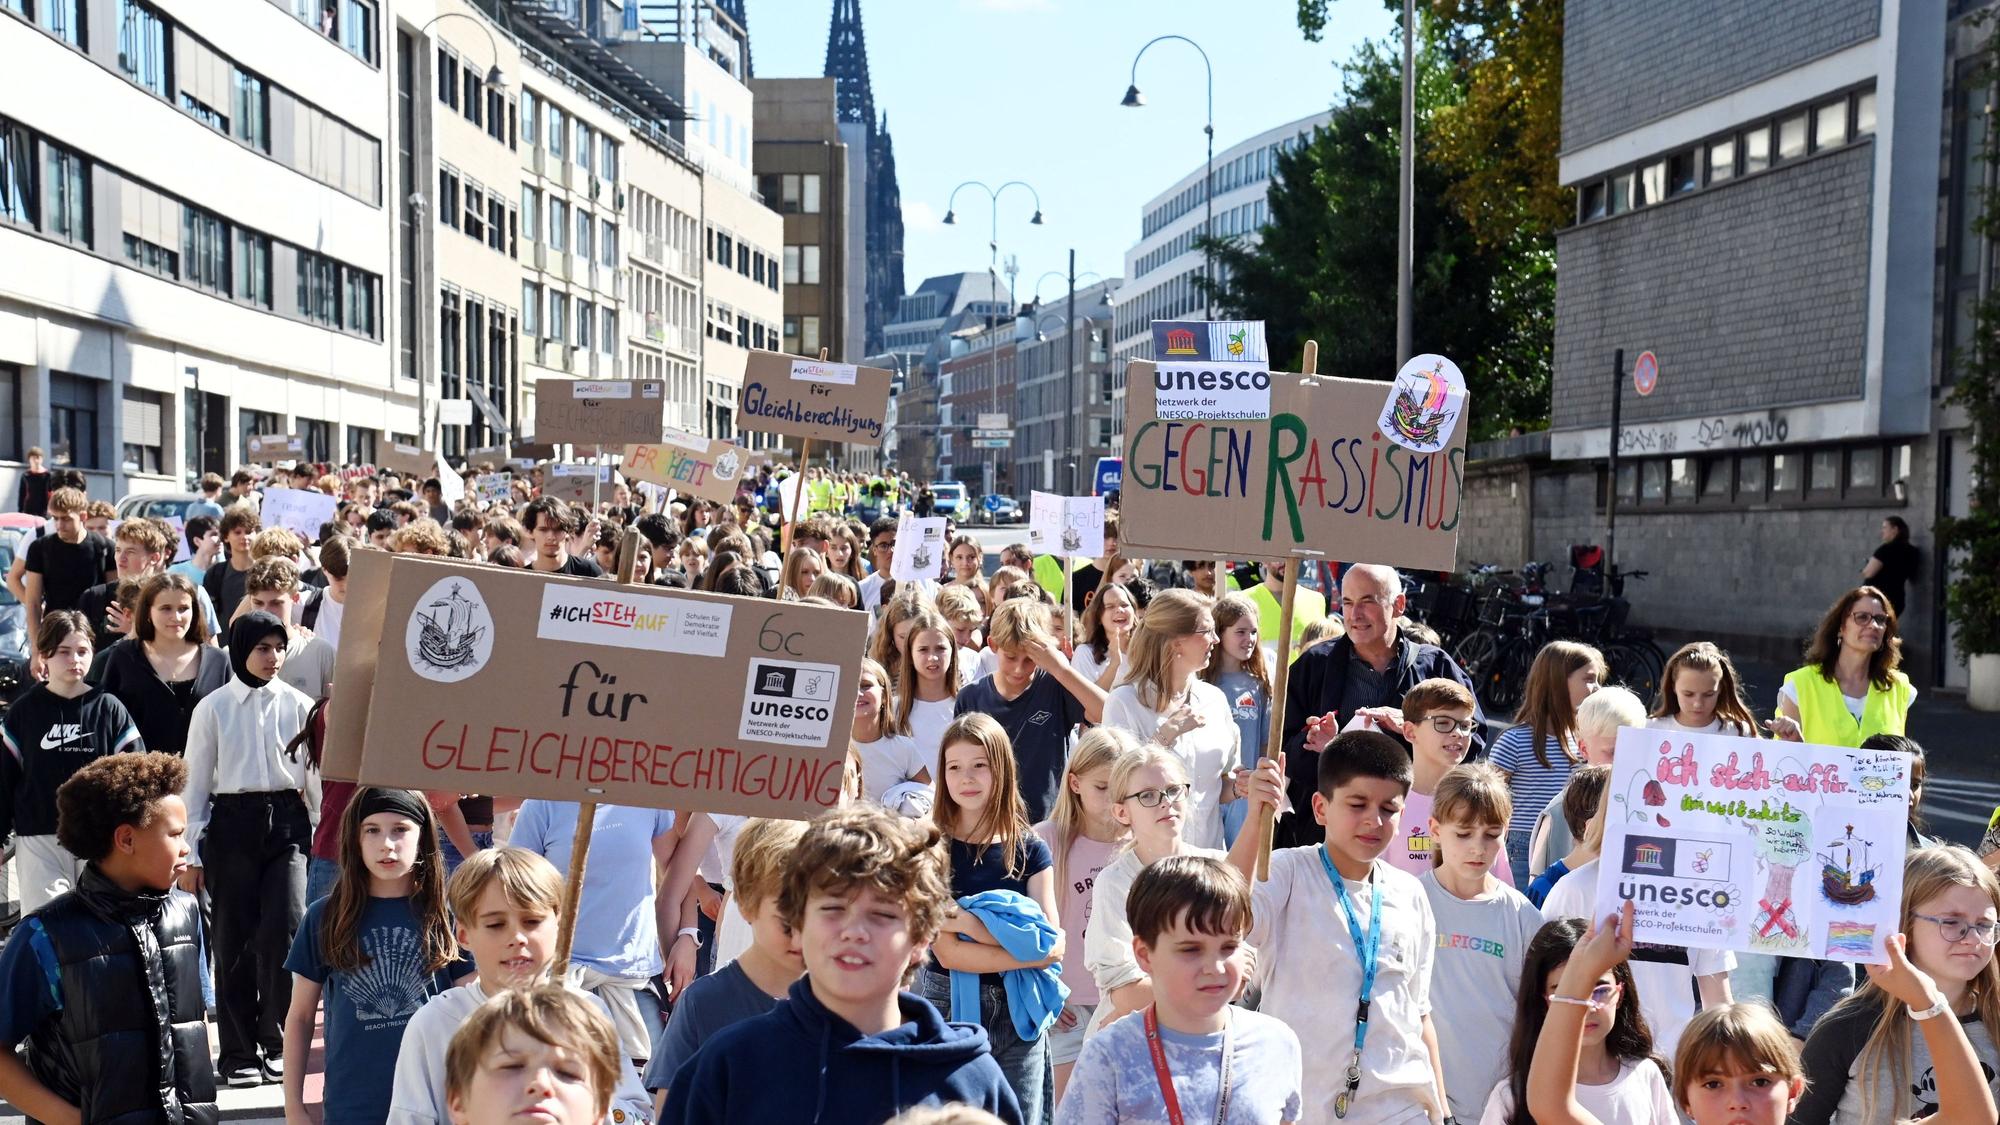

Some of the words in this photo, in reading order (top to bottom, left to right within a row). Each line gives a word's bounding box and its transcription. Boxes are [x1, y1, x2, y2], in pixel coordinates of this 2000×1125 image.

[1154, 371, 1270, 390] unesco
[810, 384, 833, 396] für
[1155, 397, 1199, 406] Netzwerk
[1201, 397, 1217, 406] der
[743, 382, 882, 438] Gleichberechtigung
[1155, 410, 1266, 420] UNESCO-Projektschulen
[1129, 421, 1251, 498] GEGEN
[686, 612, 711, 621] Schulen
[559, 660, 649, 723] für
[750, 701, 829, 721] unesco
[48, 723, 81, 738] NIKE
[748, 720, 778, 729] Netzwerk
[746, 729, 821, 741] UNESCO-Projektschulen
[421, 718, 844, 807] GLEICHBERECHTIGUNG
[1656, 740, 1699, 787] ich
[1710, 751, 1771, 791] steh
[1618, 882, 1730, 909] unesco
[1616, 906, 1659, 917] Nzwerk
[1661, 909, 1677, 918] der
[1616, 918, 1723, 935] ESCO-Projektschulen
[364, 1023, 386, 1031] BEACH
